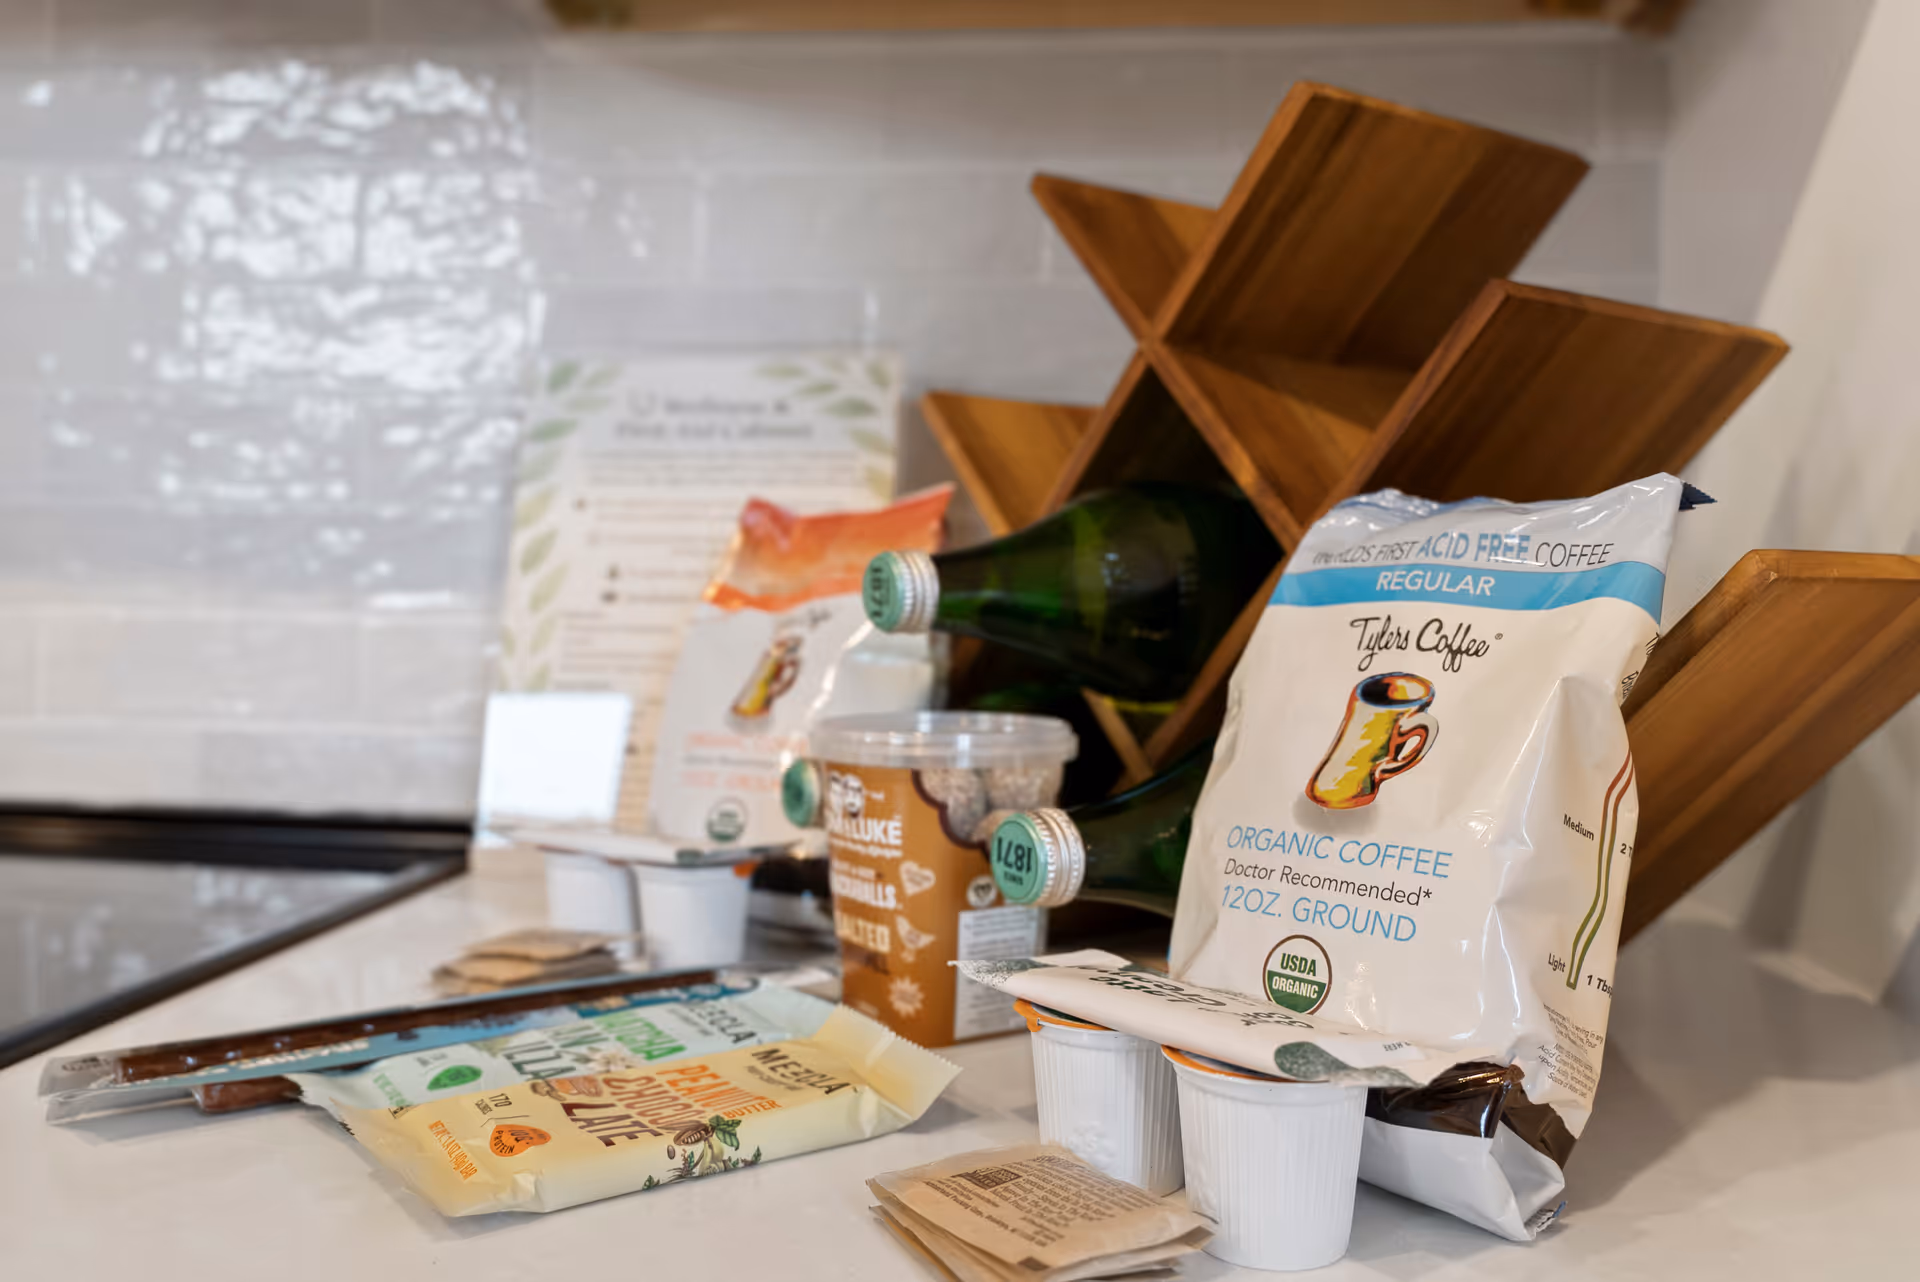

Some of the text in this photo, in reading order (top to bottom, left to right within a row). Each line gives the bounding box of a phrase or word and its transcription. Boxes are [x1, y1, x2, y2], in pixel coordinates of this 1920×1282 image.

[1374, 541, 1419, 561] FIRST
[1417, 533, 1470, 562] ACID
[1474, 532, 1532, 563] FREE
[1535, 543, 1614, 568] COFFEE
[1376, 570, 1496, 596] REGULAR
[1349, 614, 1491, 673] Tylers Coffee
[1562, 813, 1595, 841] Medium
[997, 836, 1032, 874] 1871
[1227, 825, 1453, 878] ORGANIC COFFEE
[1223, 858, 1276, 881] Doctor
[1292, 897, 1417, 942] GROUND
[1280, 953, 1317, 977] USDA
[1547, 953, 1566, 973] Light
[1272, 976, 1319, 999] ORGANIC
[1587, 974, 1593, 986] 1
[751, 1047, 851, 1095] MEZCLA
[1538, 1055, 1557, 1071] upon
[489, 1093, 512, 1107] 170
[656, 1064, 768, 1111] PEANUT
[722, 1099, 783, 1120] BUTTER
[560, 1102, 664, 1147] LATE
[494, 1130, 515, 1154] PROTEIN
